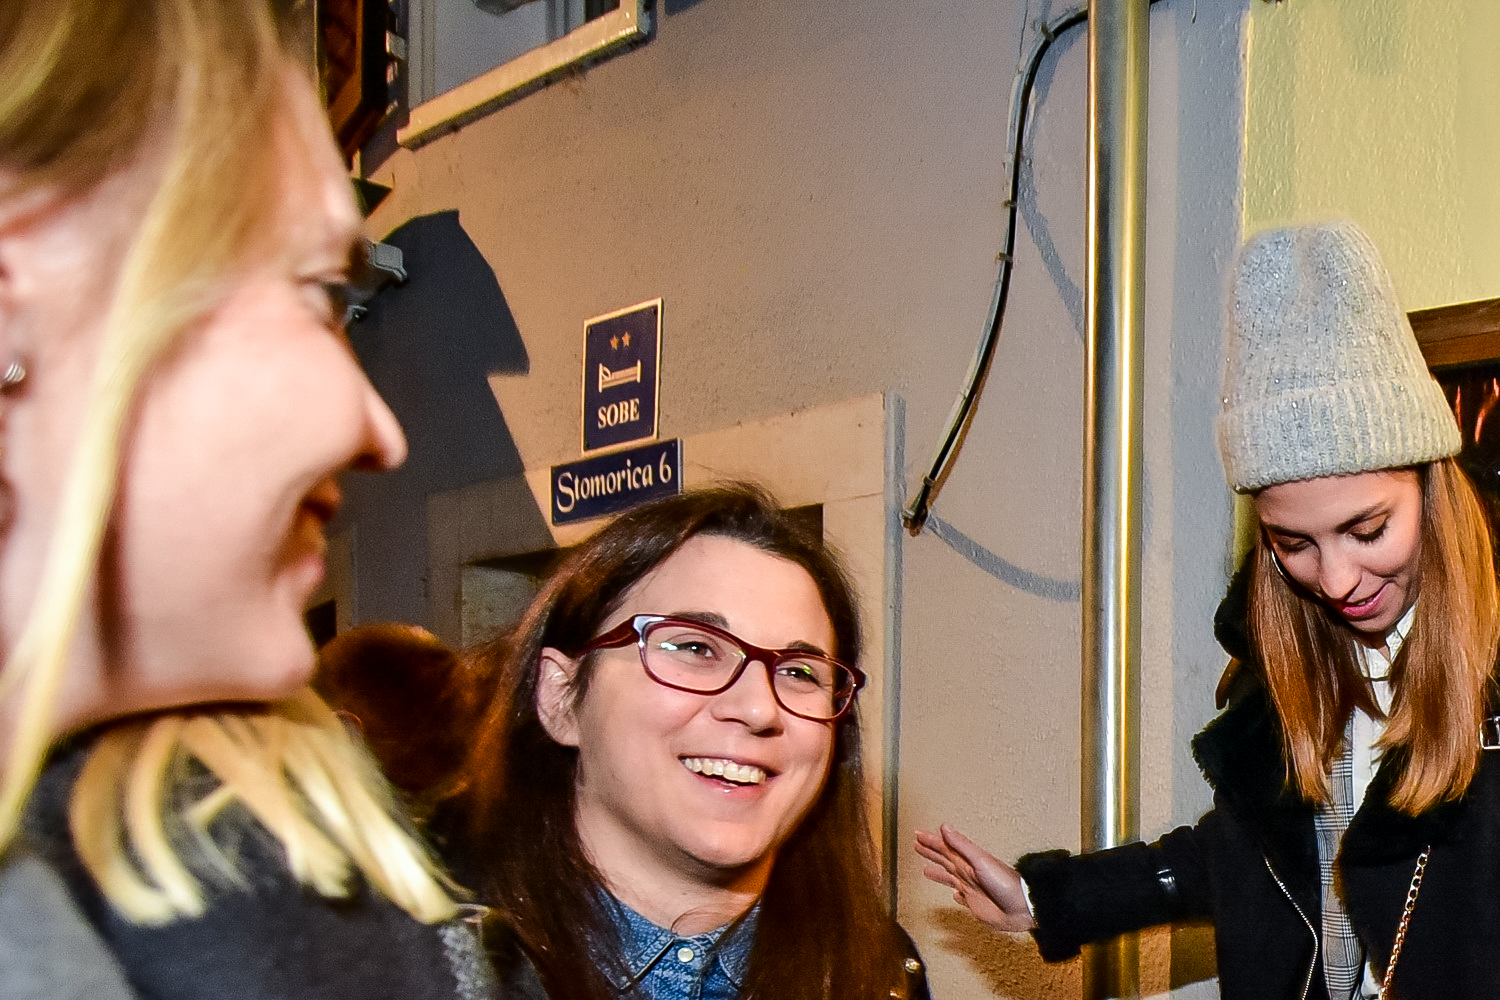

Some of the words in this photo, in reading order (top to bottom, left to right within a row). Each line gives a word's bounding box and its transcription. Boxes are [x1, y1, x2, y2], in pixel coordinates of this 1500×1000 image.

[597, 398, 640, 429] SOBE
[556, 459, 654, 513] Stomorica
[659, 451, 672, 484] 6
